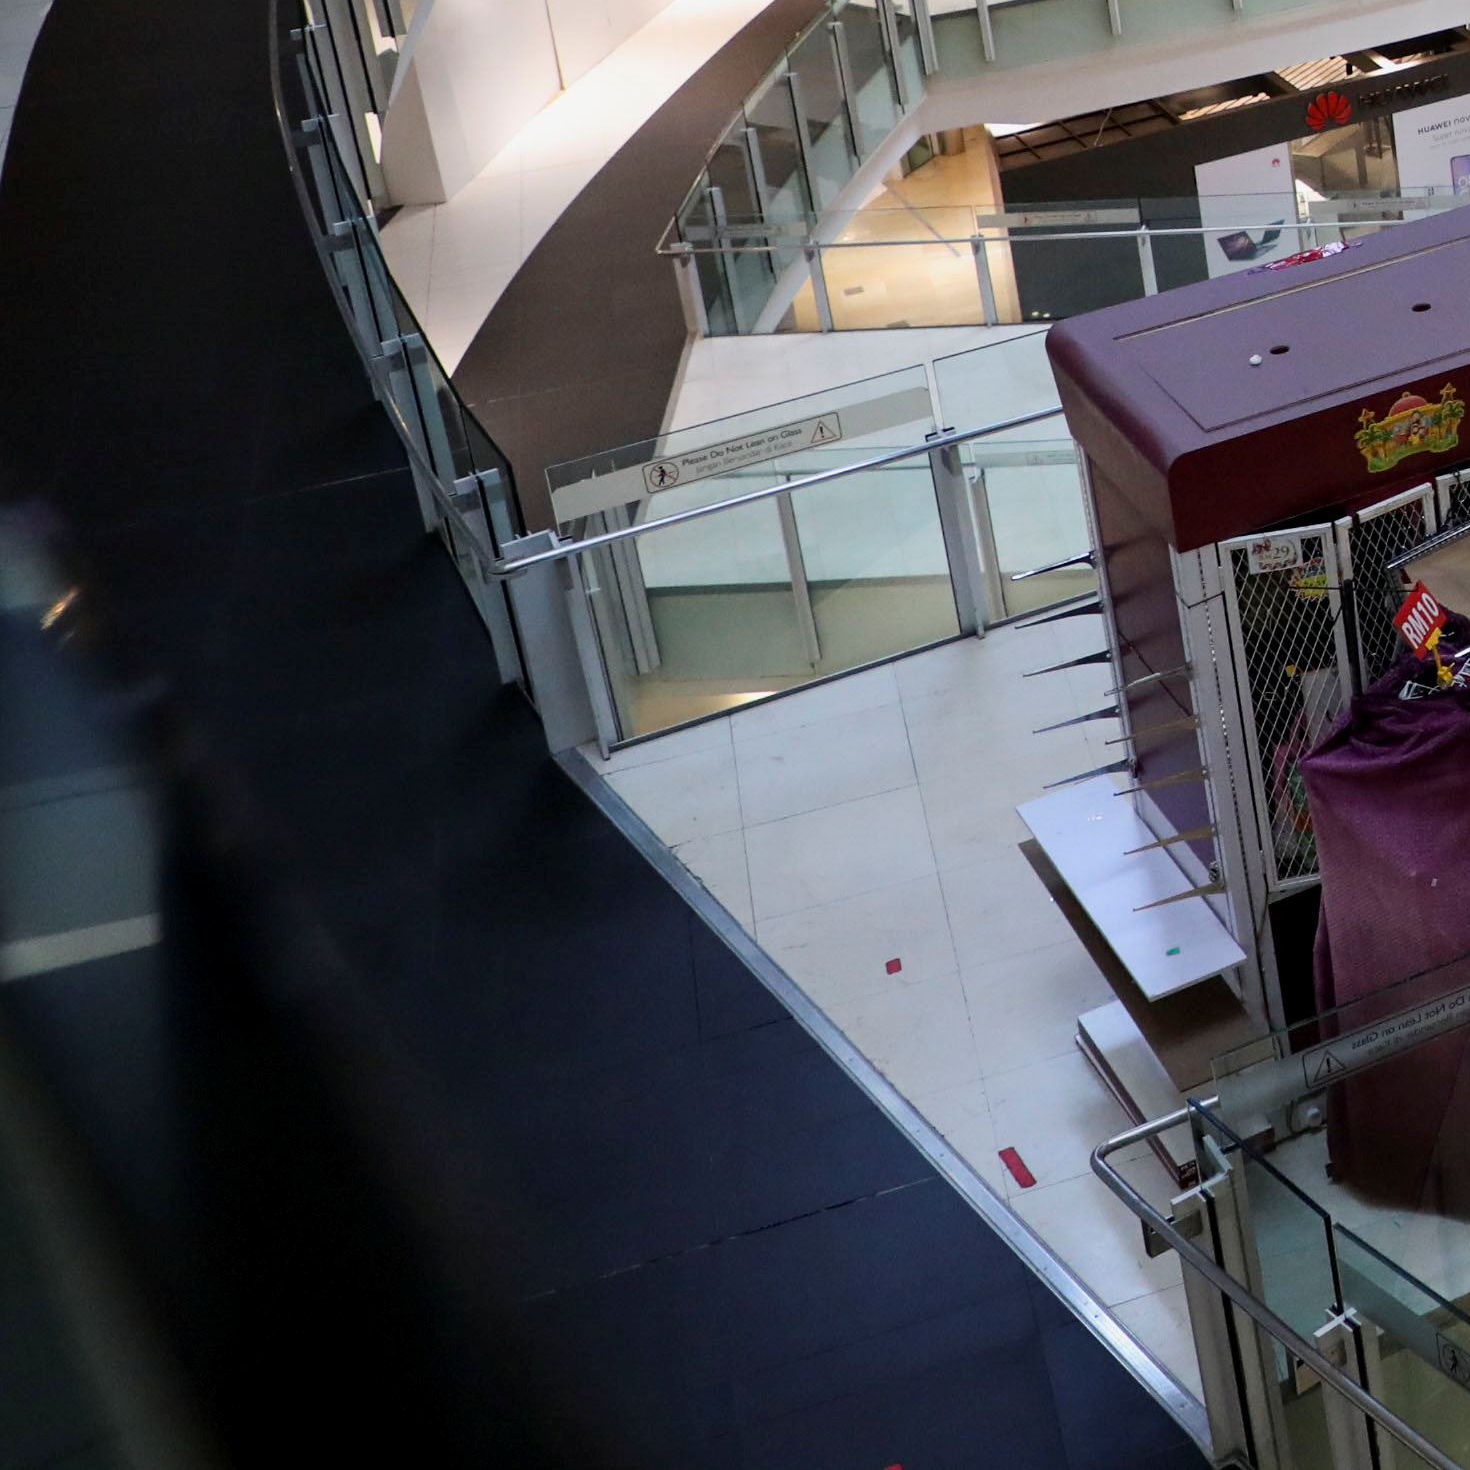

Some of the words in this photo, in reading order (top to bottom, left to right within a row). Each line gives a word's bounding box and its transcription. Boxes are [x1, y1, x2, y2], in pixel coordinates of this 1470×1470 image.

[1417, 120, 1451, 135] HUAWEI
[682, 455, 708, 467] Please
[710, 450, 724, 459] Do
[726, 444, 744, 454] Not
[745, 438, 765, 448] Lean
[767, 434, 778, 442] on
[780, 428, 802, 439] Glass
[1401, 592, 1440, 650] RM10
